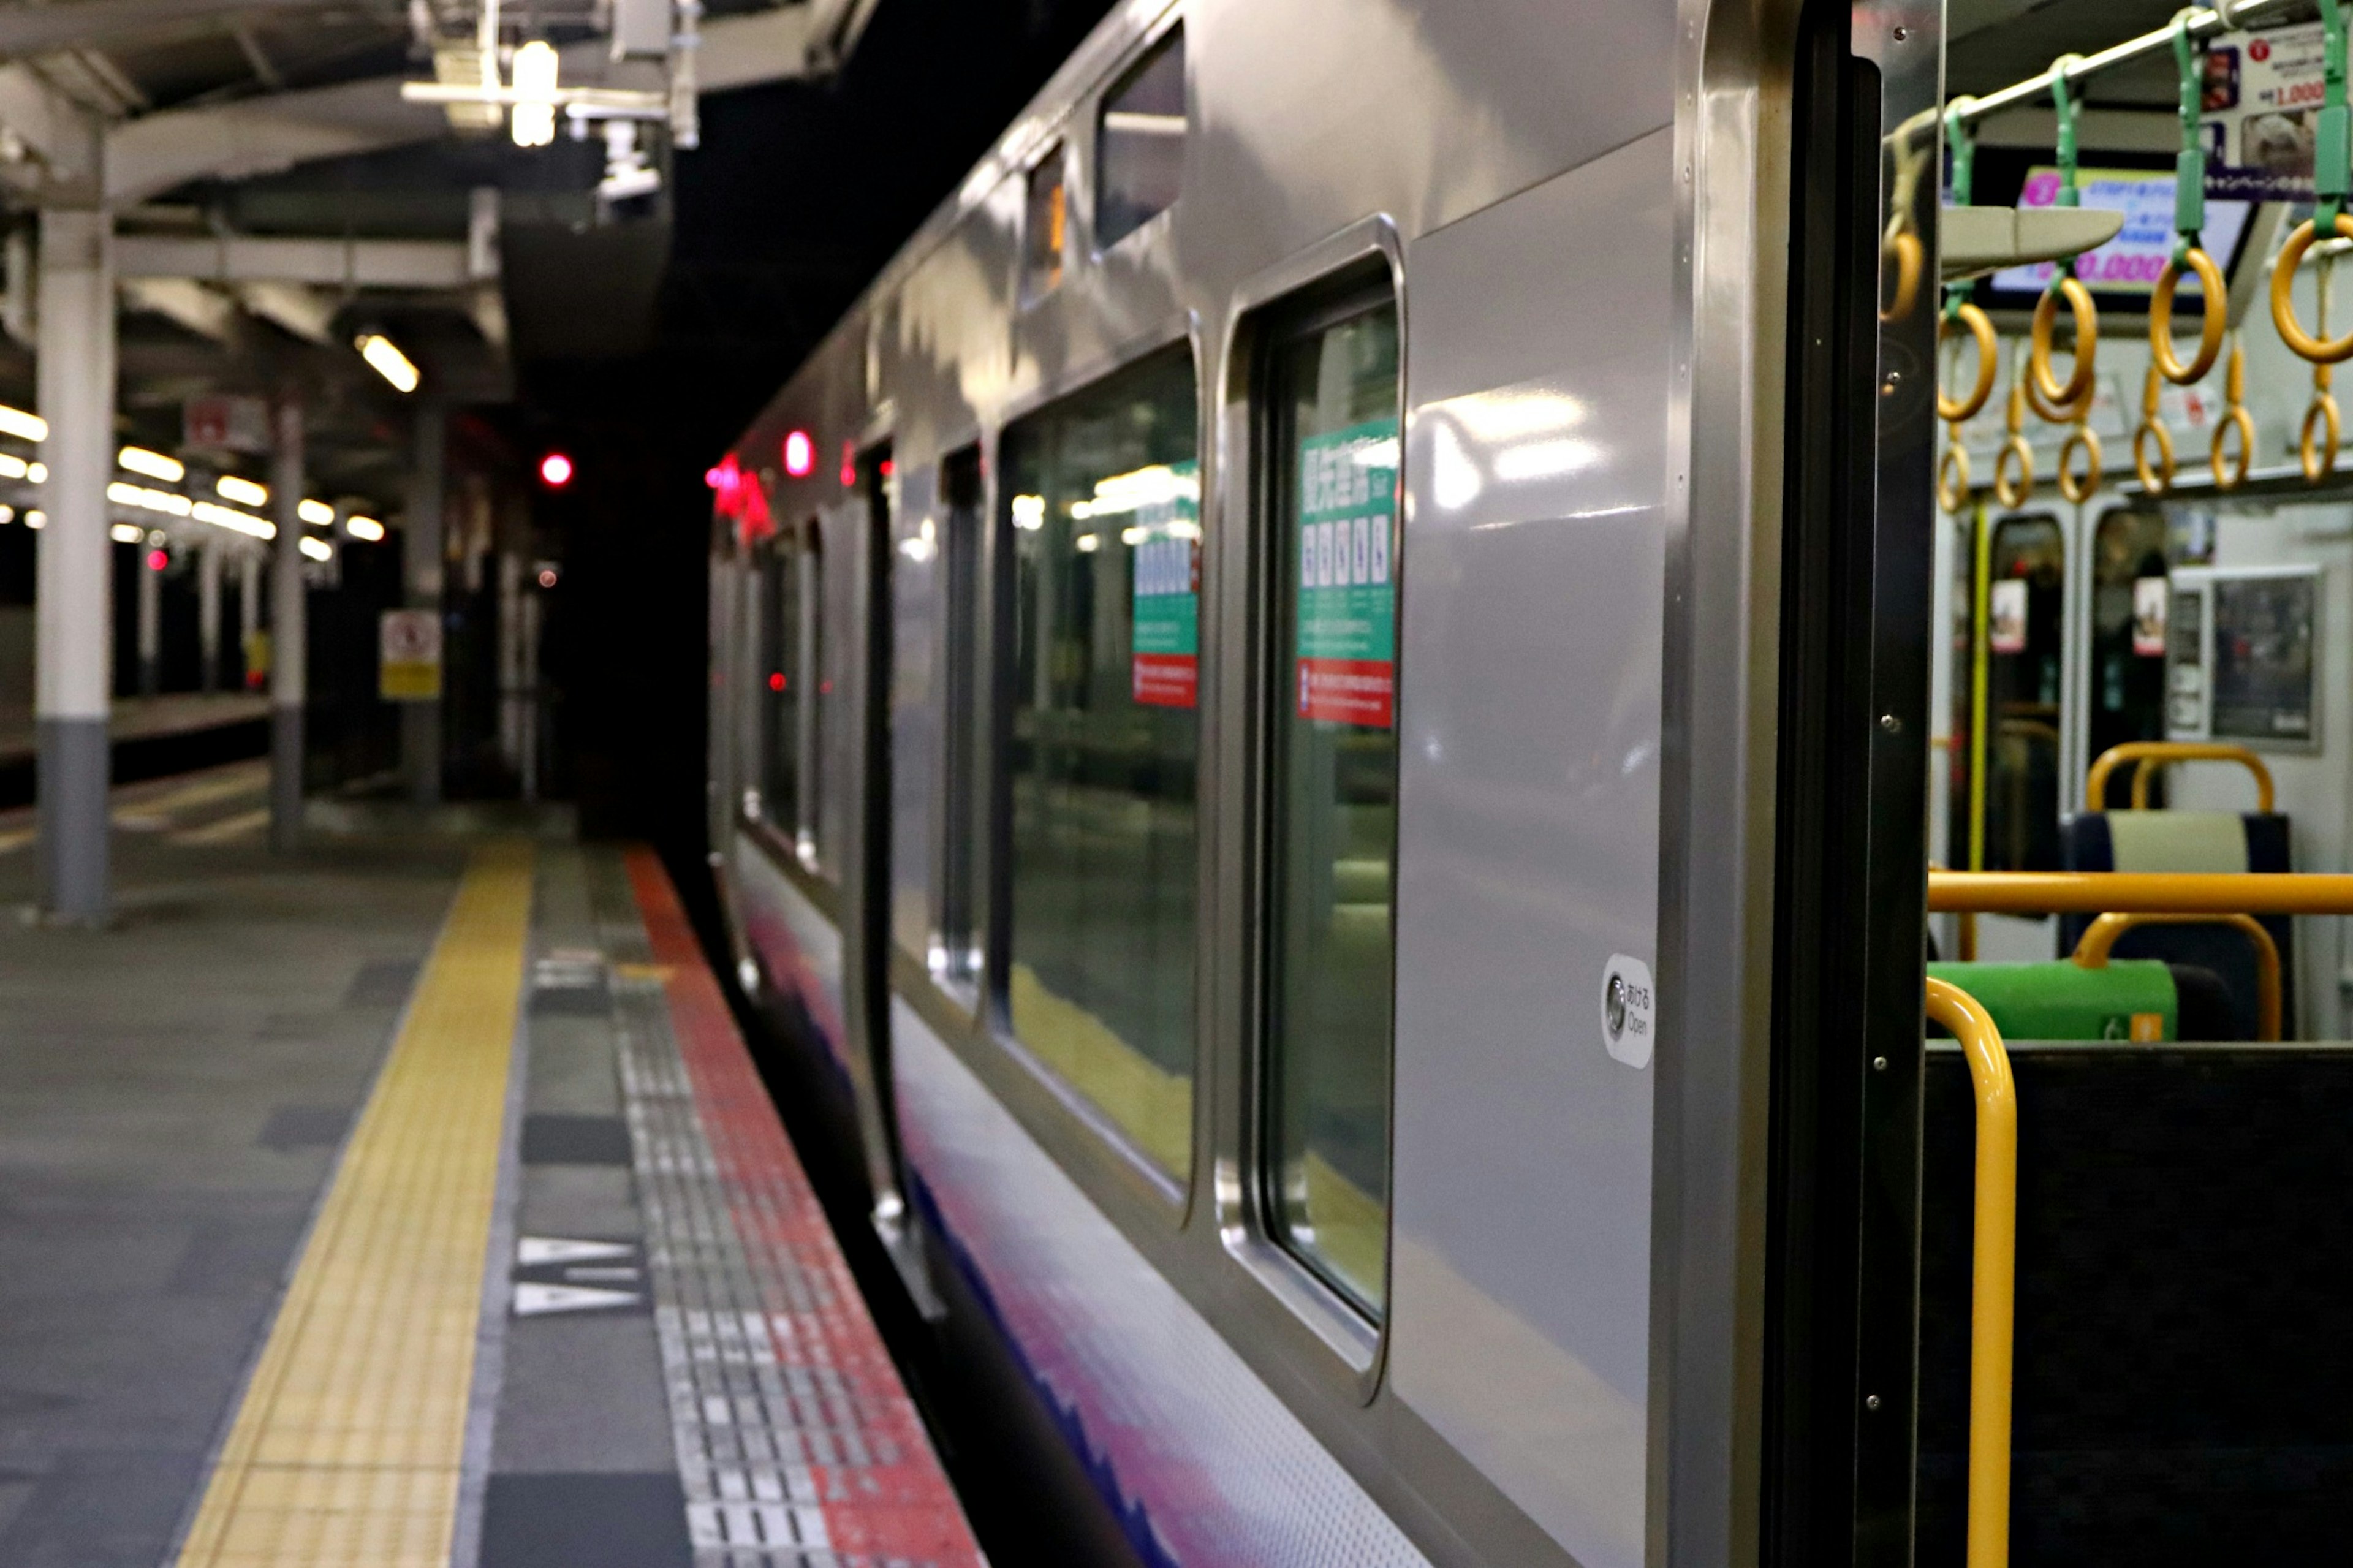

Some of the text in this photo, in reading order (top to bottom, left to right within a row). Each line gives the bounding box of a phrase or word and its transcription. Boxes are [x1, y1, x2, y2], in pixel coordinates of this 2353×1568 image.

[1627, 984, 1650, 1010] あける
[1628, 1011, 1647, 1036] Open
